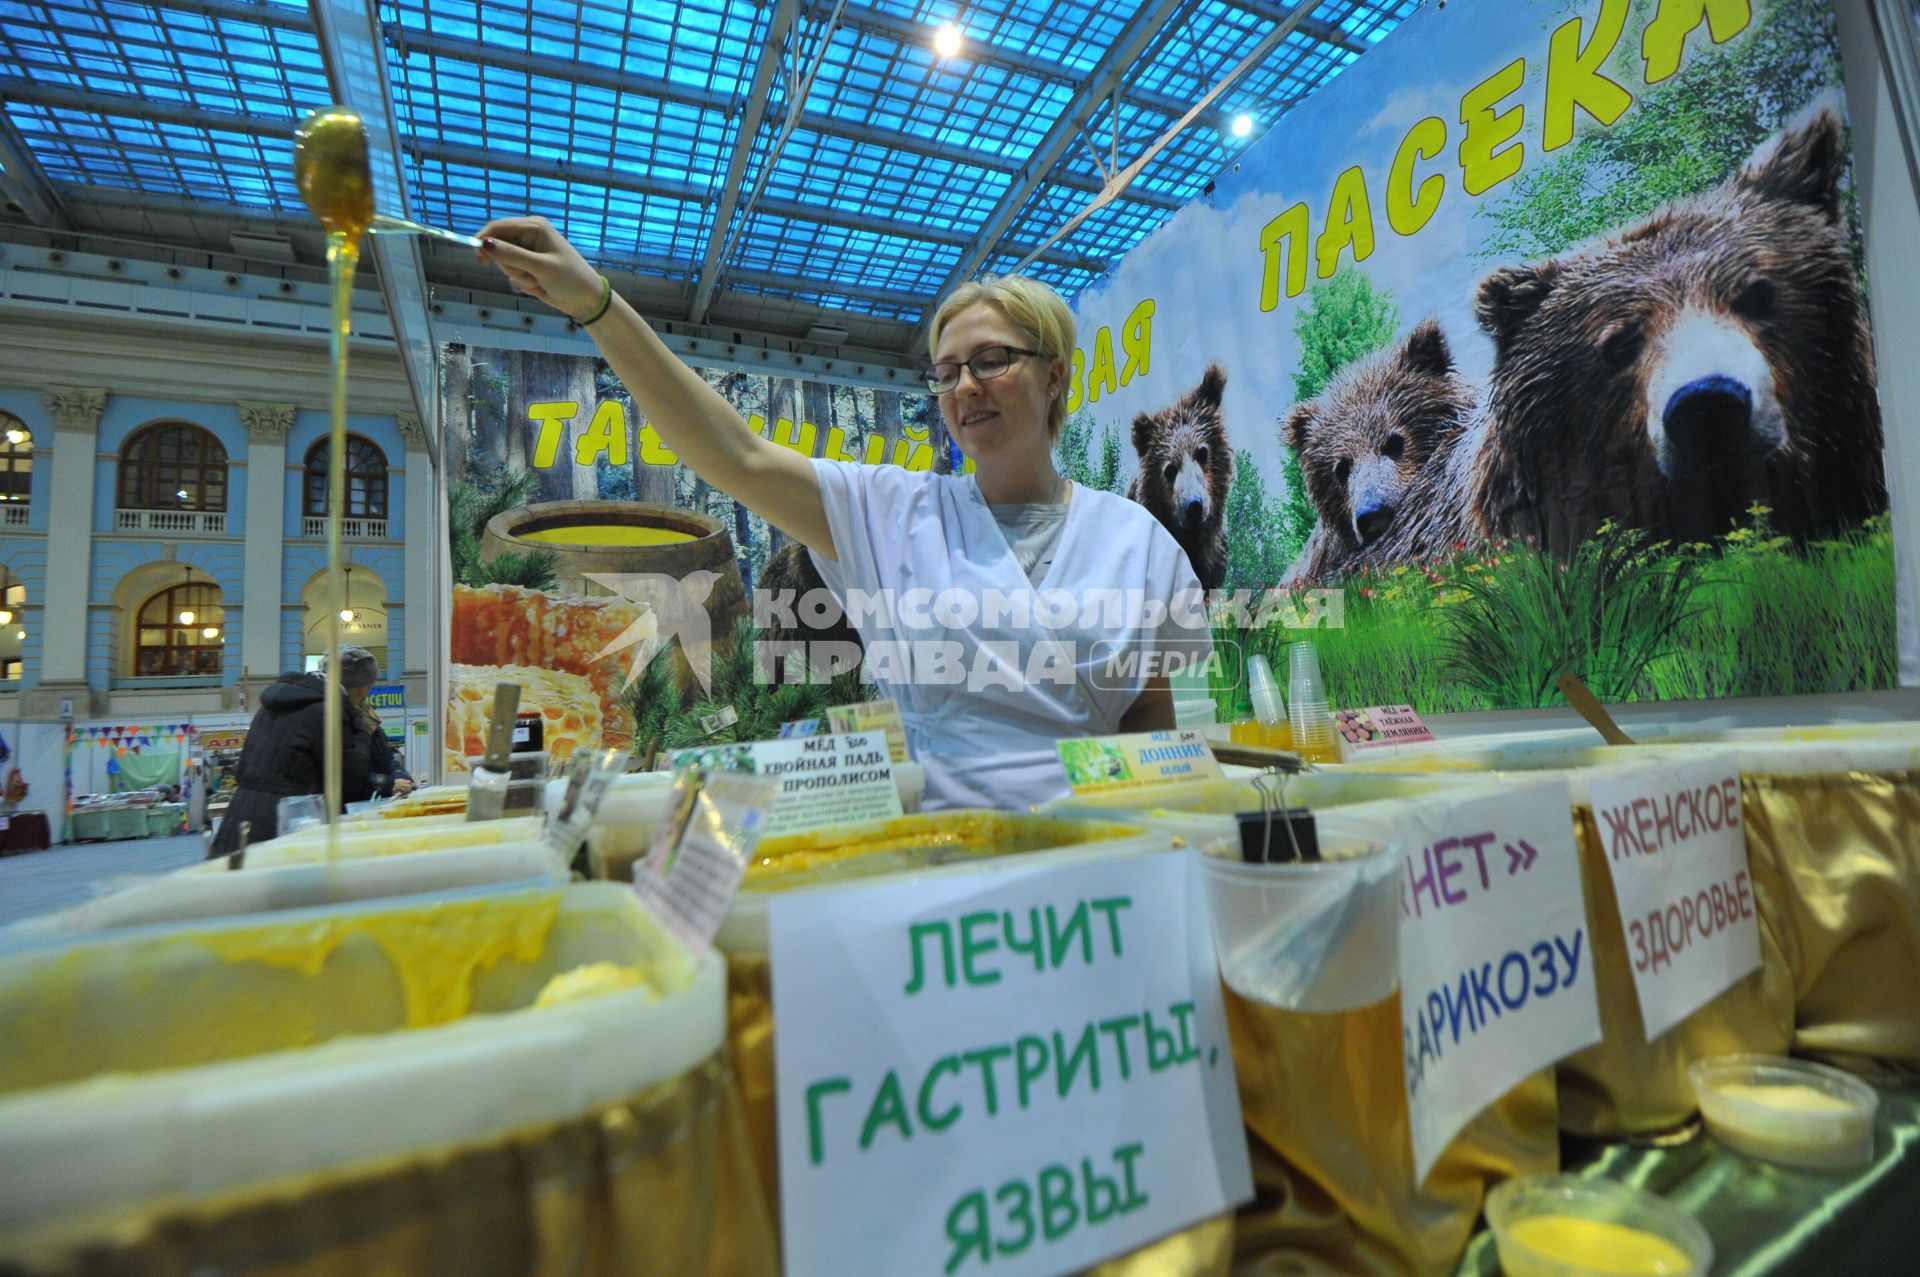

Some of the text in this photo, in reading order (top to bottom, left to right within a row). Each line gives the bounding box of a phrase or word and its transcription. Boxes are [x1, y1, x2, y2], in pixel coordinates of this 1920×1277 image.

[1259, 0, 1752, 312] ПАСЕКА
[528, 400, 934, 472] ТАЕНЫЙ
[763, 756, 837, 776] ХВОЙНАЯ
[845, 751, 884, 767] ПАДЬ
[1138, 743, 1206, 765] ДОННИК
[1382, 726, 1430, 739] ЗЕМЛЯНИКА
[783, 768, 890, 792] ПРОПОЛИСОМ
[1602, 777, 1740, 863] ЖЕНСКОЕ
[904, 896, 1133, 995] ЛЕЧИТ
[1629, 870, 1753, 976] ЗДОРОВЬЕ
[804, 1000, 1219, 1166] ГАСТРИТЫ,
[943, 1141, 1151, 1276] ЯЗВЫ
